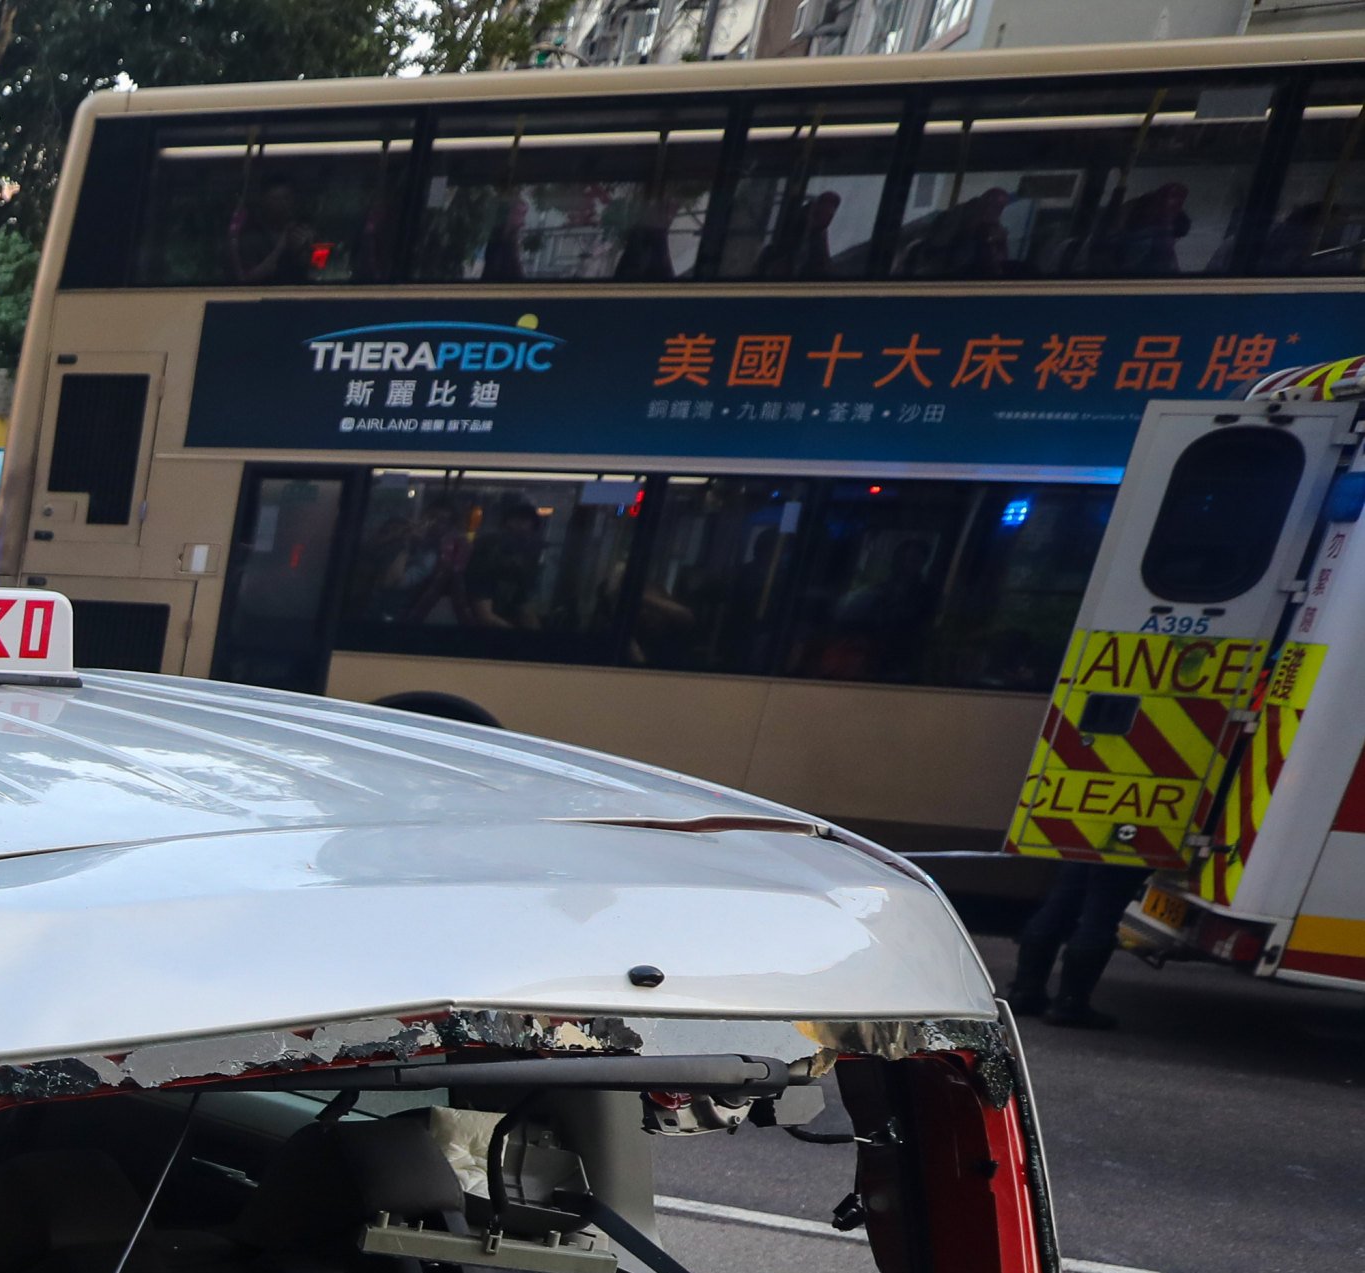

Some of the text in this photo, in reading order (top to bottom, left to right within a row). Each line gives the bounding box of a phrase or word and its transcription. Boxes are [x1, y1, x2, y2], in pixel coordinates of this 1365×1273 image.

[310, 341, 557, 371] THERAPEDIC
[344, 379, 501, 409] 斯麗比迪
[356, 418, 419, 431] AIRLAND
[1140, 616, 1211, 635] A395
[1019, 774, 1186, 821] CLEAR
